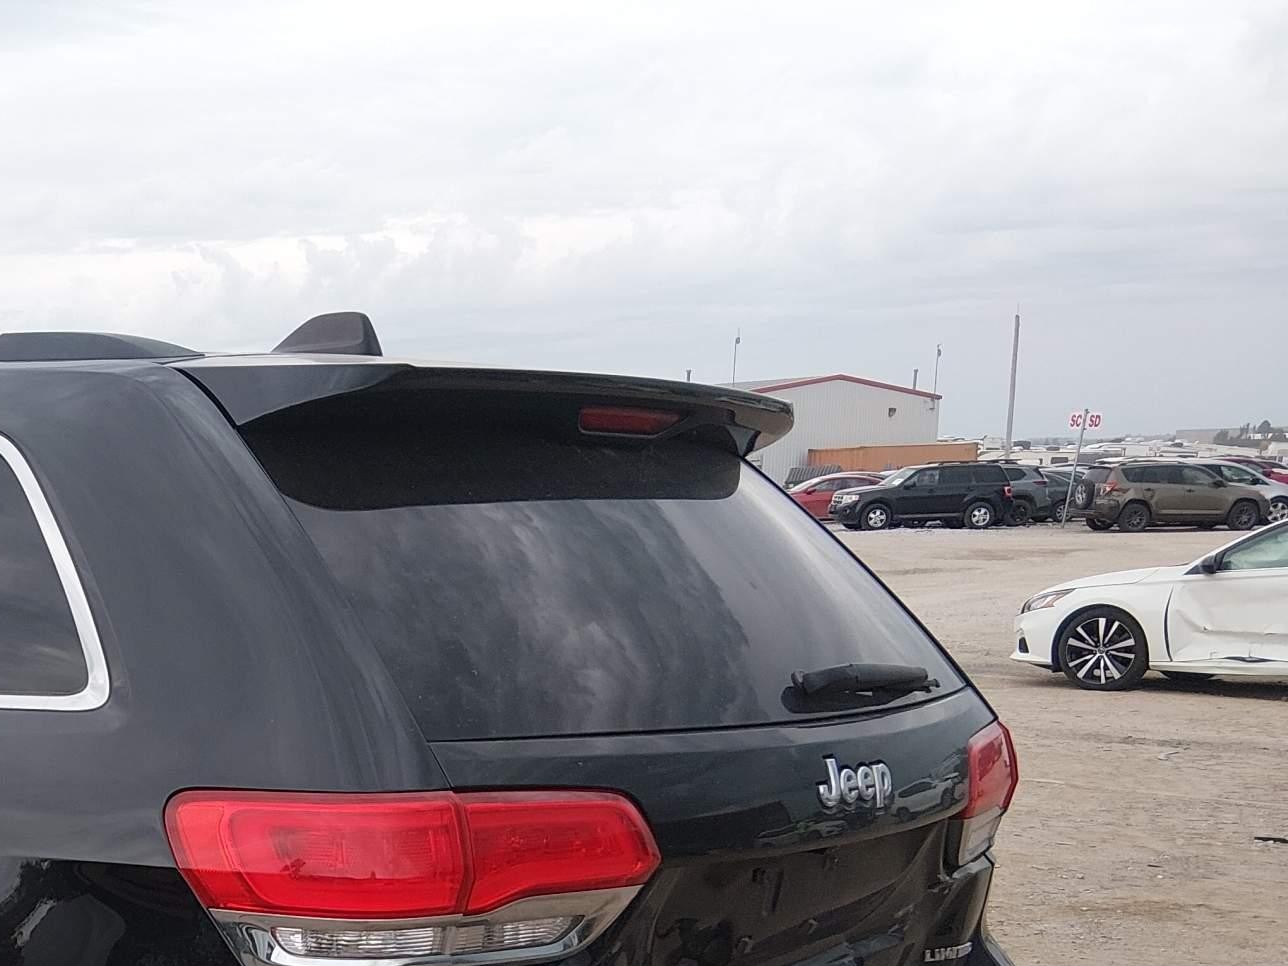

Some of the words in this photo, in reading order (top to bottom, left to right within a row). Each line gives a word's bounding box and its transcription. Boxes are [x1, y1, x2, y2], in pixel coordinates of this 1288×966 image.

[1069, 413, 1083, 428] SC
[1088, 413, 1102, 428] SD
[817, 756, 893, 809] Jeep
